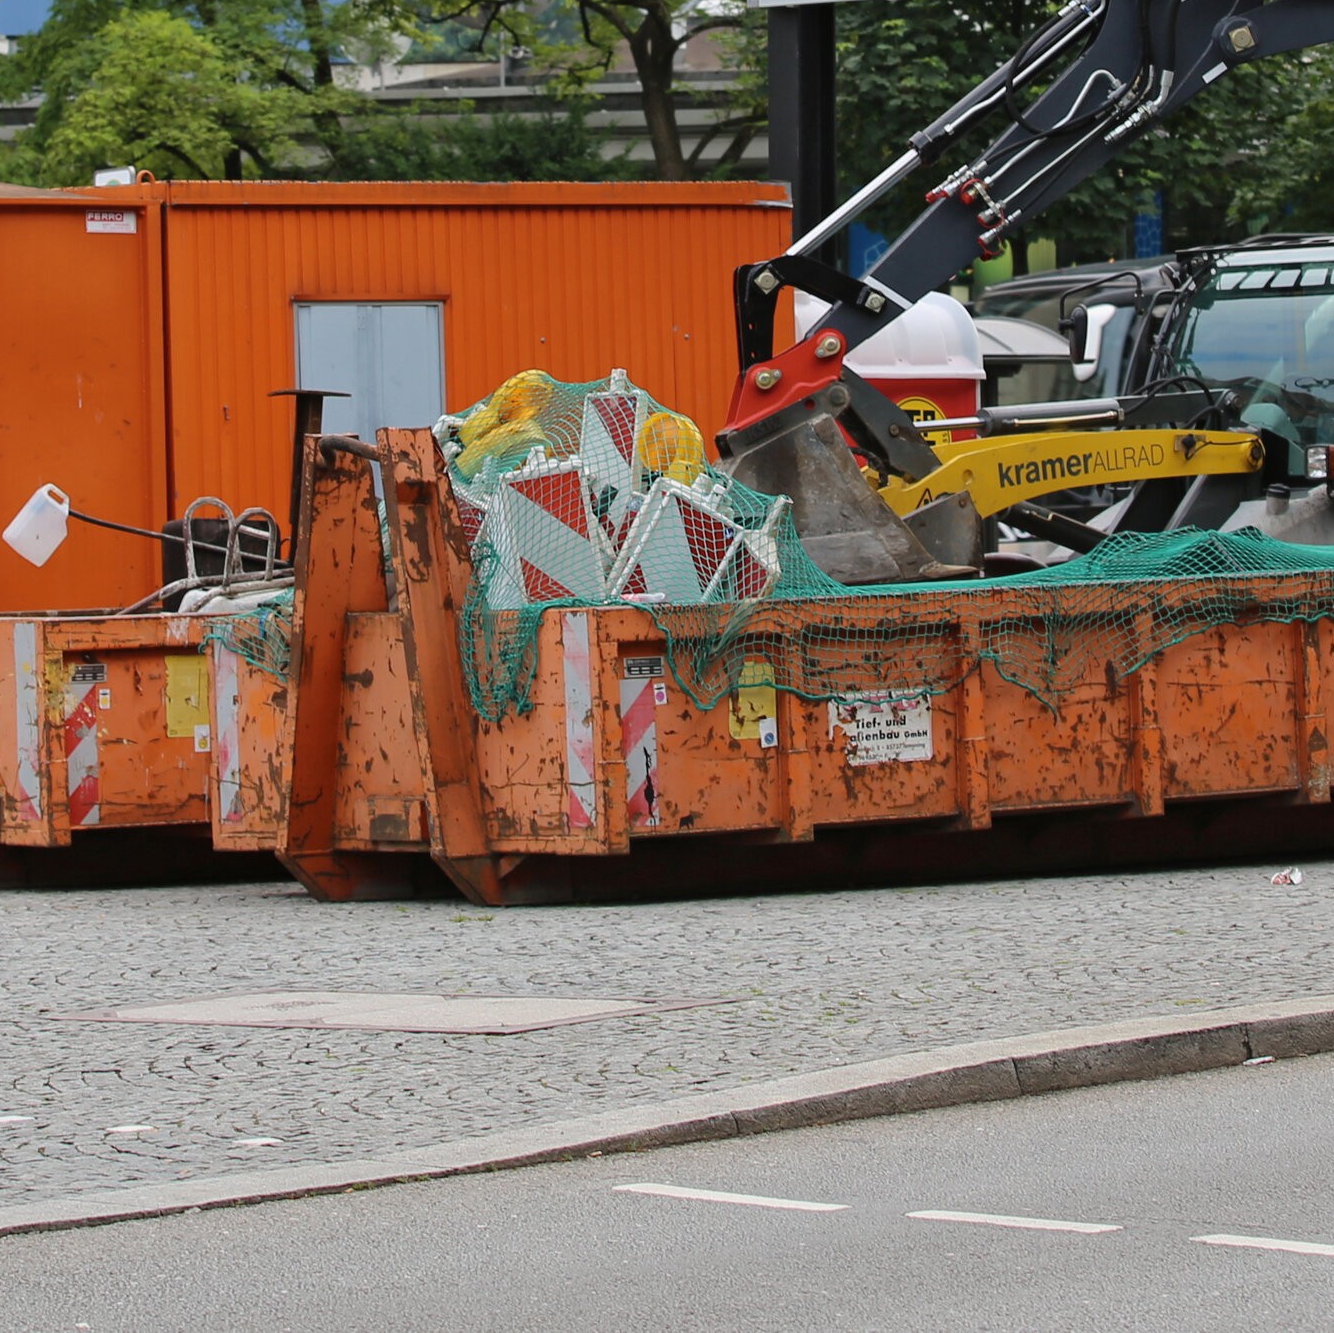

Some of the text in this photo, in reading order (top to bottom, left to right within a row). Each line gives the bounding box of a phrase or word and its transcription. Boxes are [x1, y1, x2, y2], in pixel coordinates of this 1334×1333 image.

[88, 212, 123, 222] FERRO
[856, 715, 906, 729] Tief- und
[904, 730, 928, 738] GmbH
